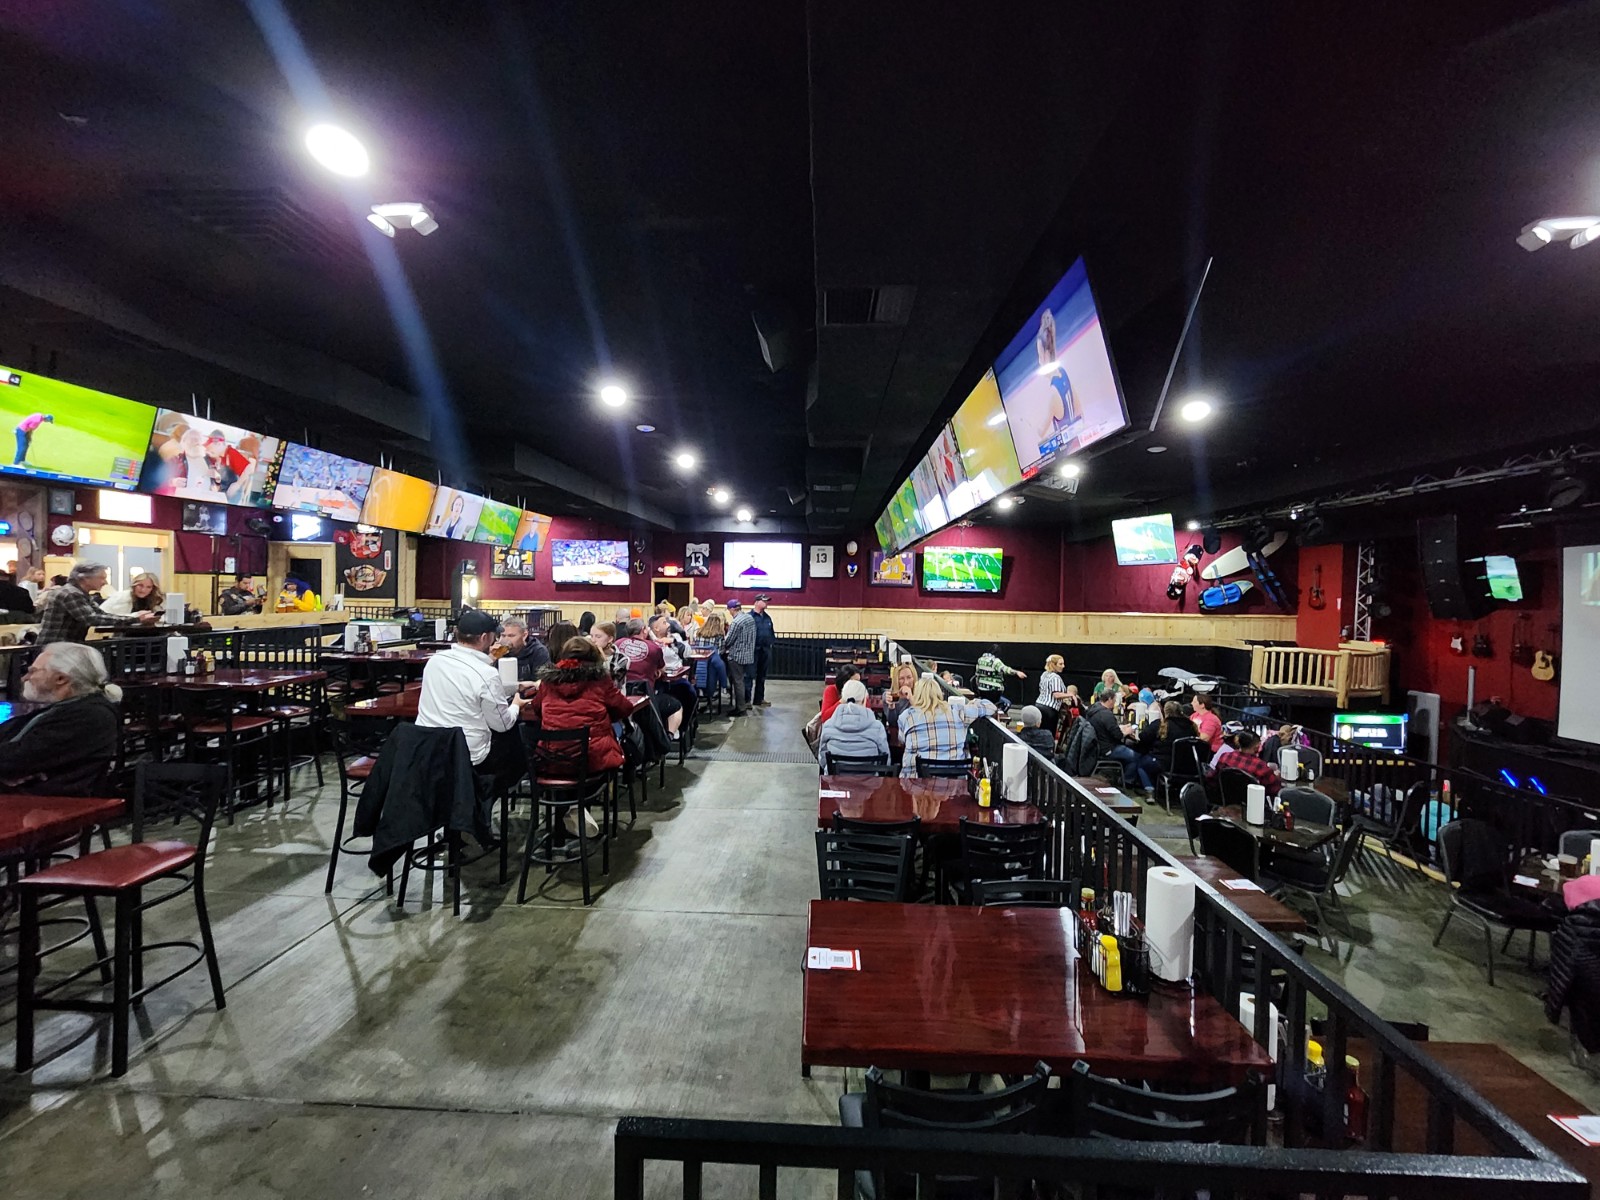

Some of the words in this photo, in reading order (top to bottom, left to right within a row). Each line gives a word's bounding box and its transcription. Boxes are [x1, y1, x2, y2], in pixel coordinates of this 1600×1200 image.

[506, 555, 520, 569] 90
[690, 553, 703, 567] 13
[816, 553, 827, 563] 13
